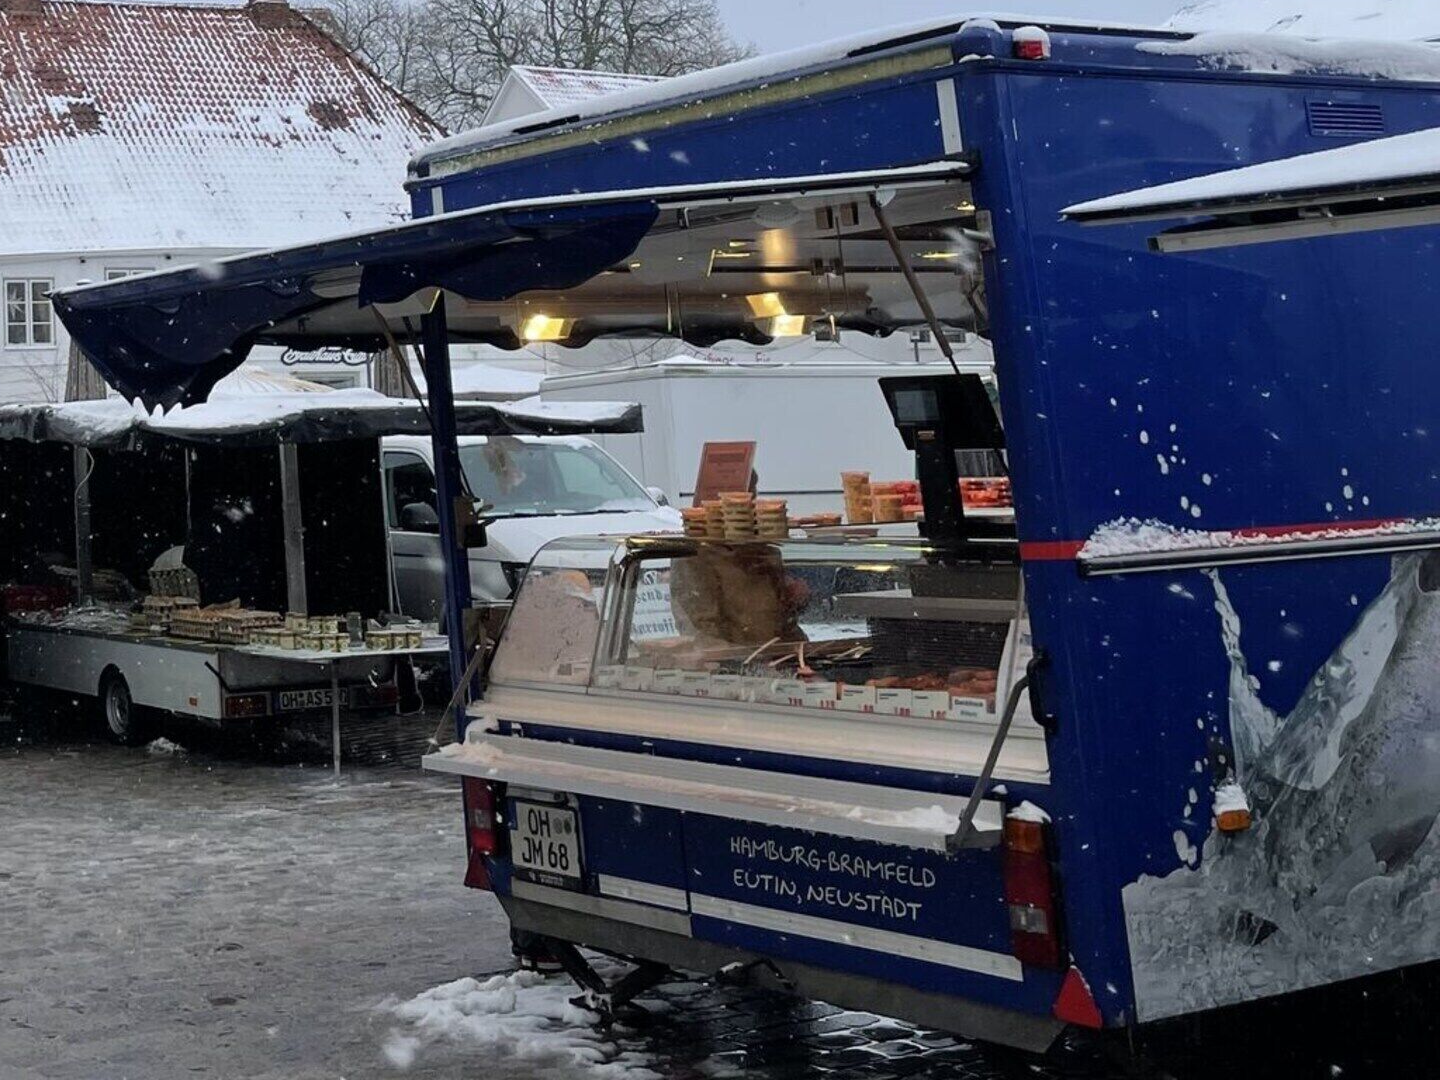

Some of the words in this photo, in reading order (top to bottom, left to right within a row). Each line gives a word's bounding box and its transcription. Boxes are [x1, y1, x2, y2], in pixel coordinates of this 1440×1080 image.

[528, 807, 551, 838] OH
[521, 836, 544, 867] JM
[548, 841, 569, 871] 68
[730, 836, 936, 888] HAMBURG-BRAMFELD
[807, 884, 922, 921] NEUSTADT
